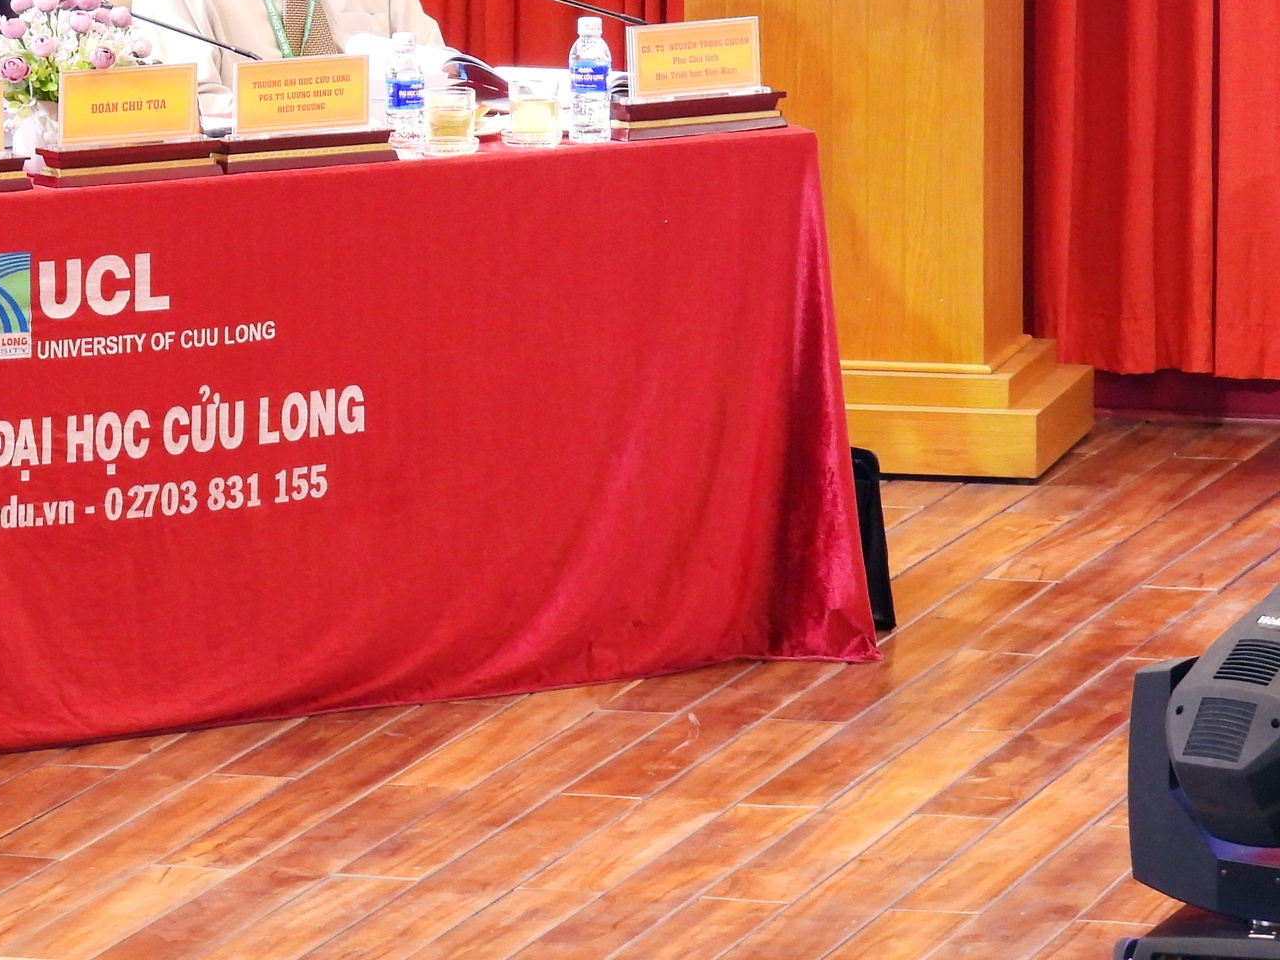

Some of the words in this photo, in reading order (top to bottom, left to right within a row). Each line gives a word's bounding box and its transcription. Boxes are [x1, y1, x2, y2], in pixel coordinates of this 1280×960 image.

[721, 66, 738, 75] Nam
[332, 74, 350, 83] LONG
[313, 89, 332, 98] MINH
[146, 99, 167, 112] TỌA
[39, 252, 170, 319] UCL
[1, 337, 28, 347] LONG
[37, 333, 147, 359] UNIVERSITY
[150, 331, 176, 351] OF
[181, 327, 219, 349] CUU
[224, 320, 276, 345] LONG
[67, 409, 150, 475] HỌC
[163, 384, 245, 456] CỬU
[258, 384, 366, 445] LONG
[84, 505, 95, 514] -
[207, 472, 261, 512] 831
[274, 463, 328, 503] 155
